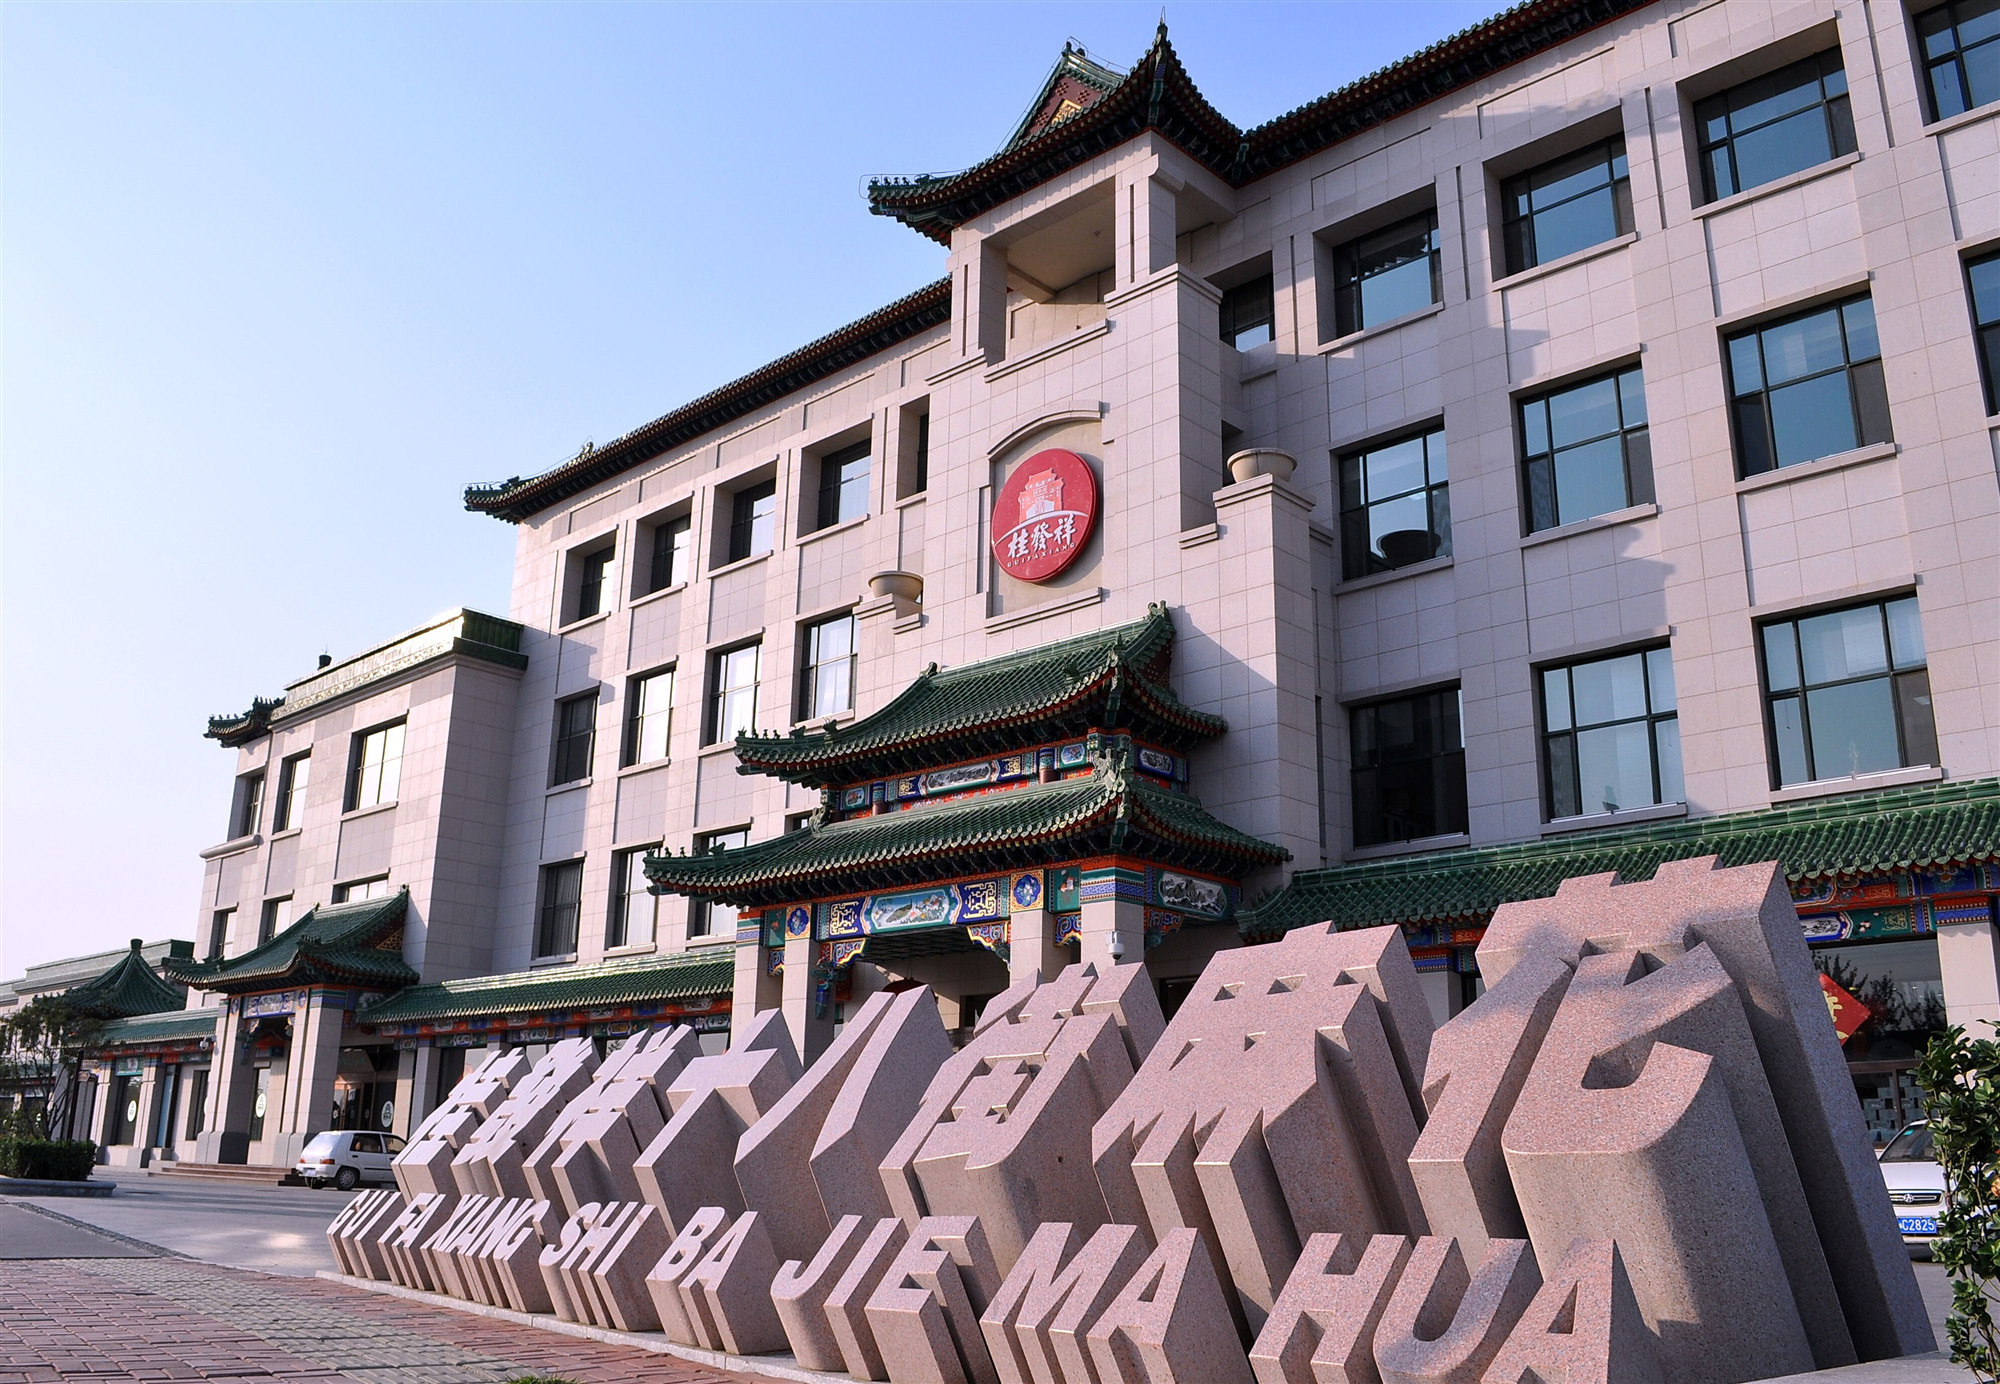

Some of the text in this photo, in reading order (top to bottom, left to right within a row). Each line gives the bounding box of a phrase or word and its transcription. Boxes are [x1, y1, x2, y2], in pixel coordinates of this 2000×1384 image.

[1007, 542, 1075, 567] GUIFAXIANG
[326, 1189, 1614, 1384] GUI FA XIANG SHI BA JIE MA HUA
